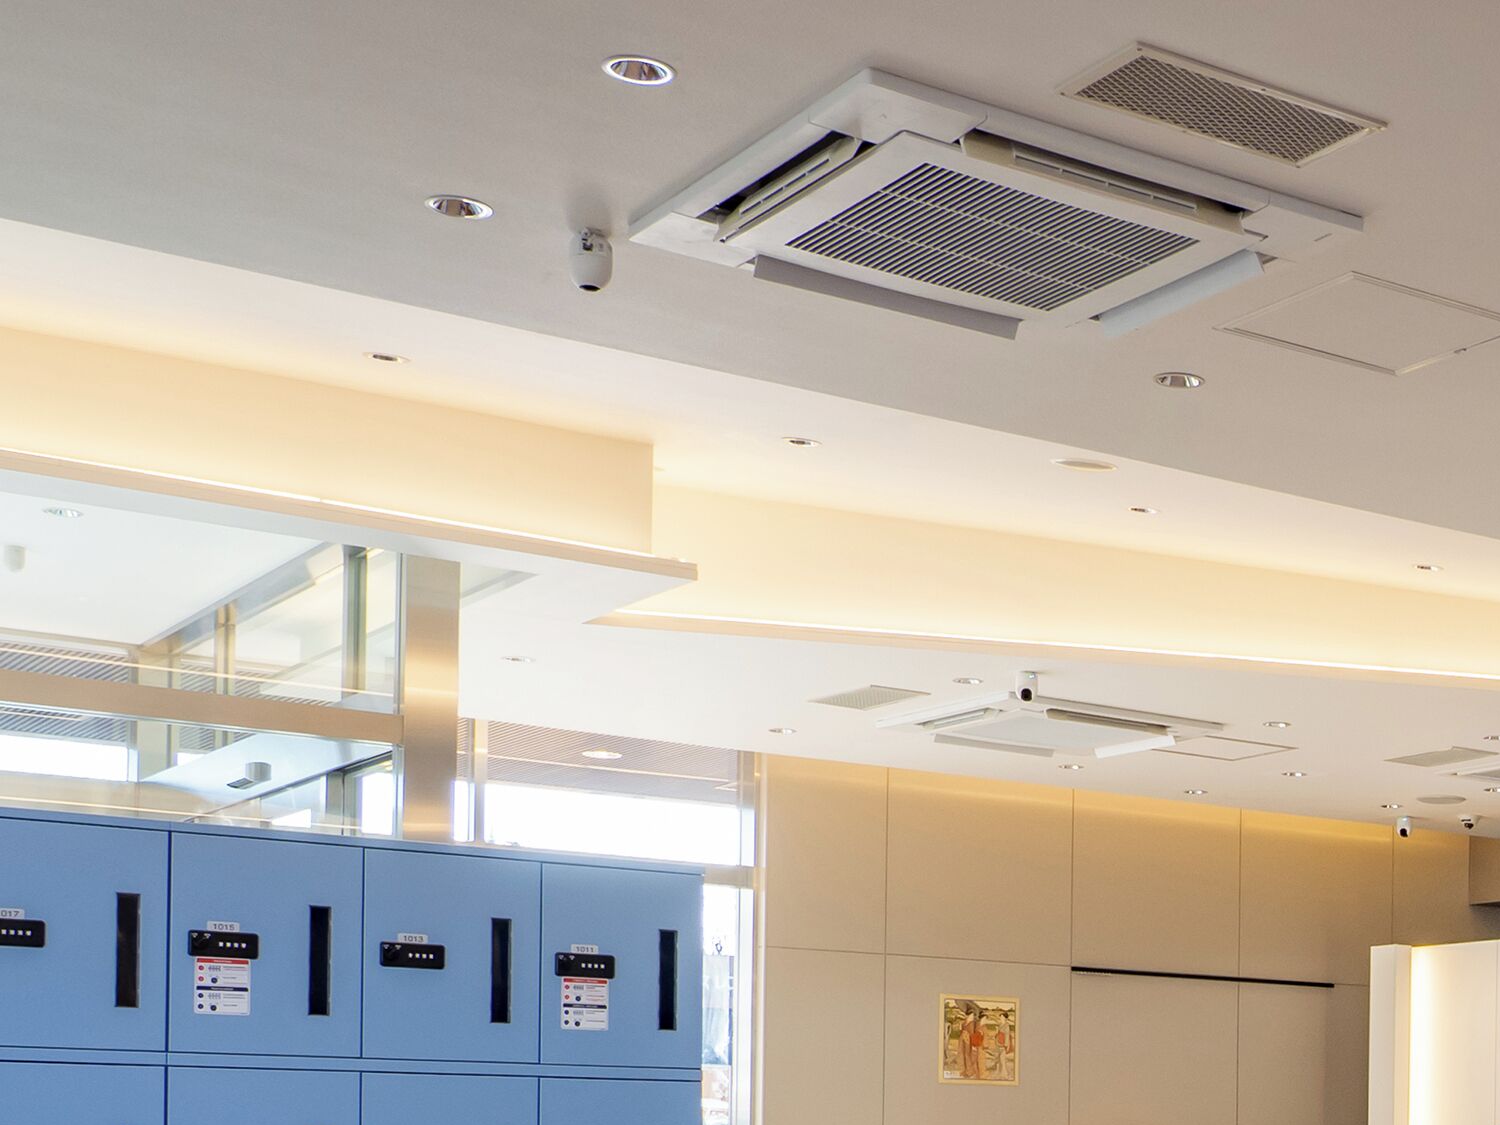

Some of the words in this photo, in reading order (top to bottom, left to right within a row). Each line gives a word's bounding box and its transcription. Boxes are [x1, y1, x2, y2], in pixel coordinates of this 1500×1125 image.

[0, 910, 20, 918] 017
[213, 923, 235, 932] 1015
[403, 935, 425, 943] 1013
[576, 945, 594, 953] 1011
